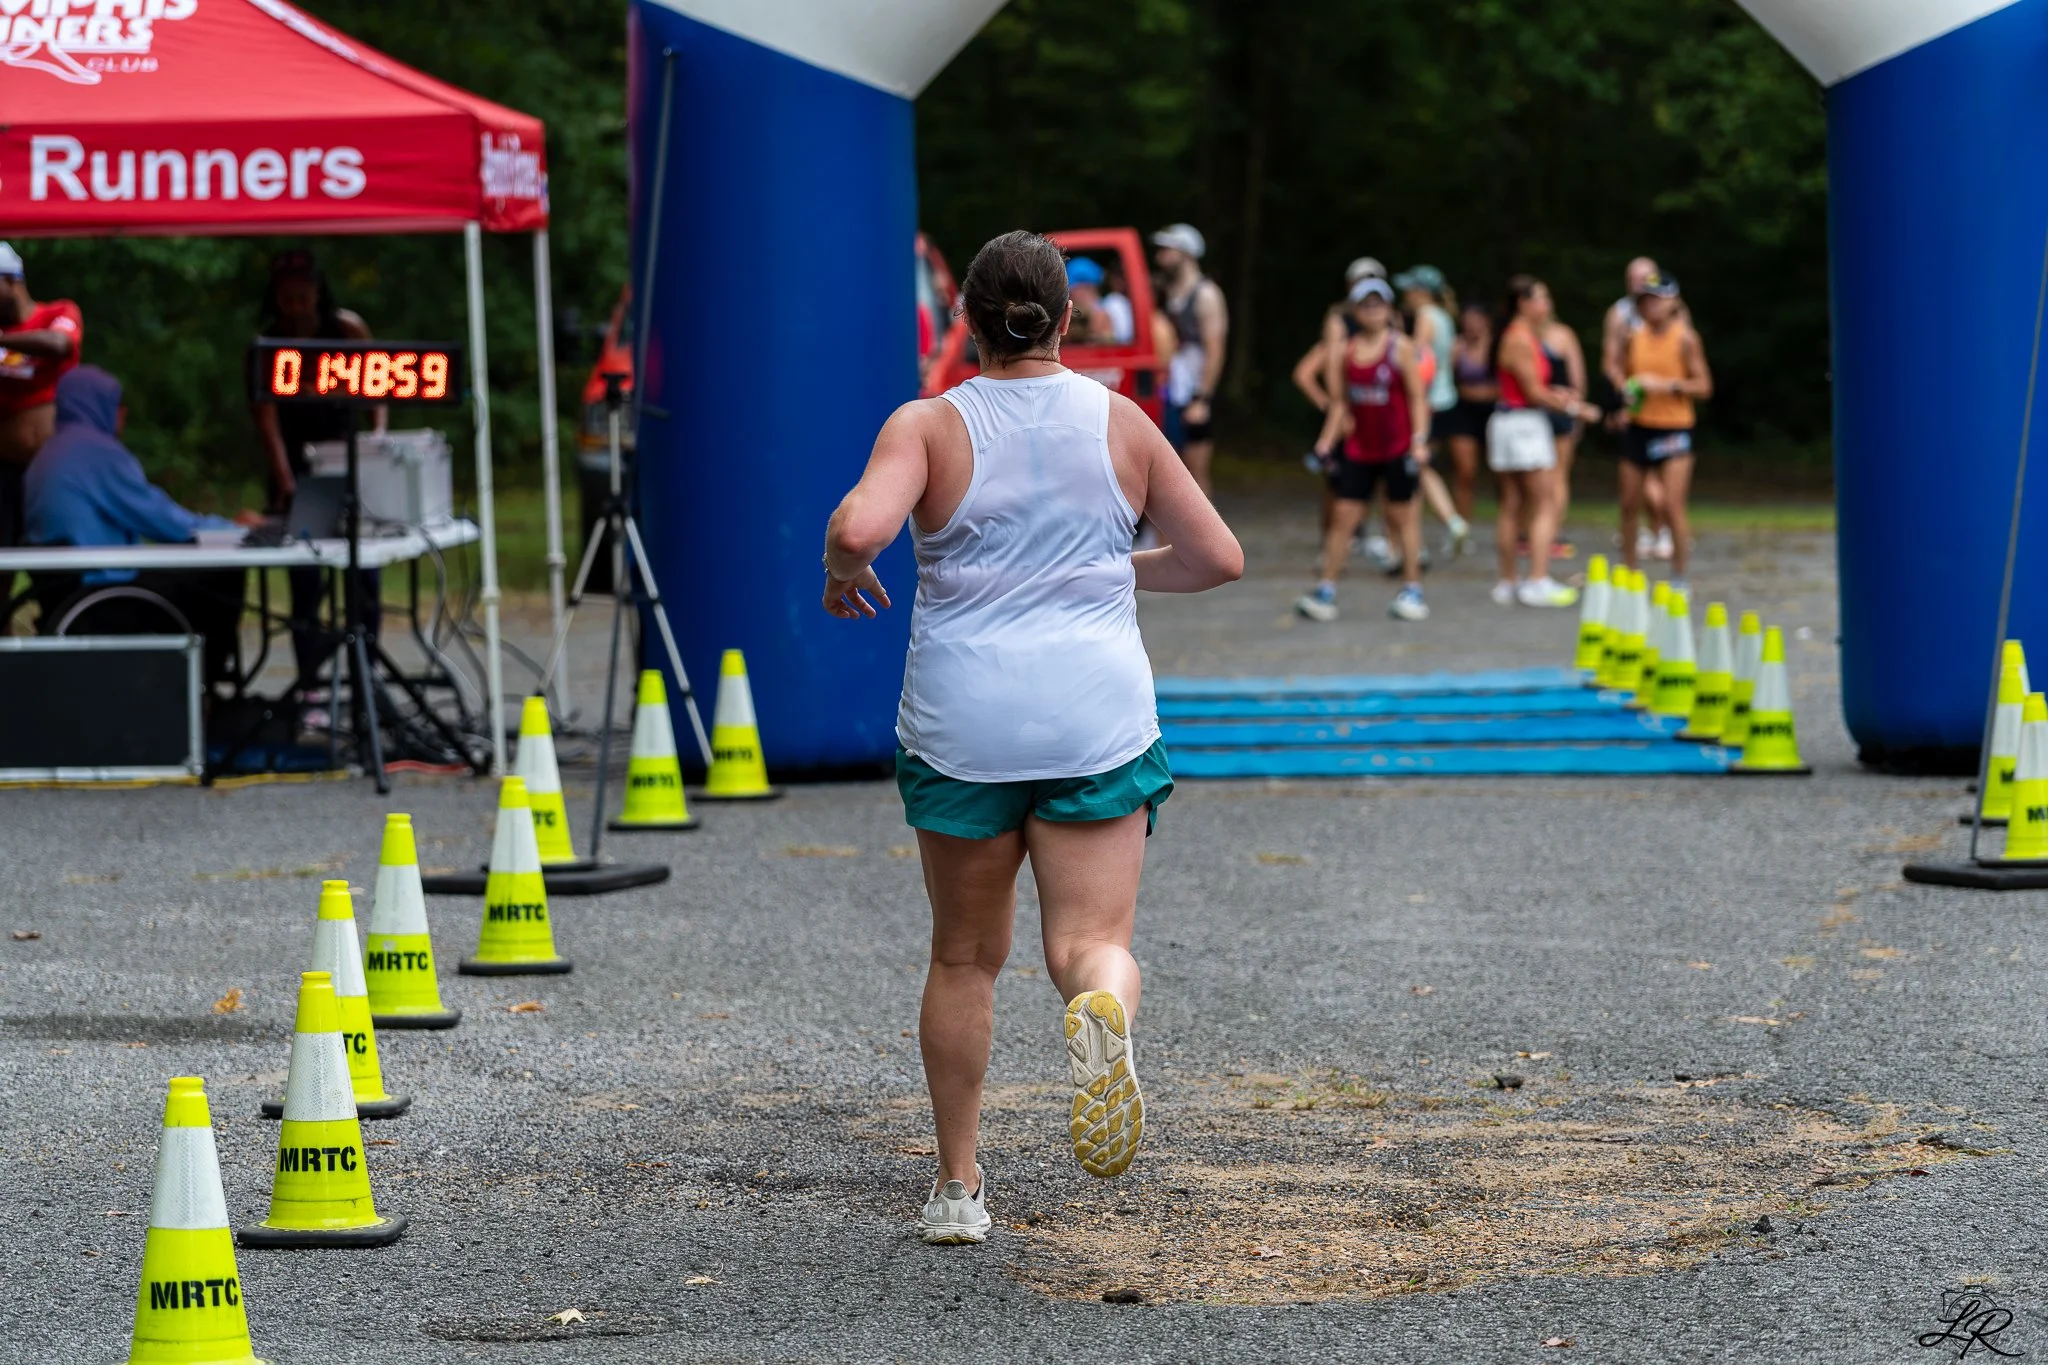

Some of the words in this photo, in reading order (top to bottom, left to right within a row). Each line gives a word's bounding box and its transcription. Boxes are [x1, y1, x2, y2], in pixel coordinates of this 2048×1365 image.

[29, 134, 367, 201] Runners
[489, 904, 545, 921] MRTC
[367, 951, 428, 970] MRTC
[280, 1145, 357, 1172] MRTC
[151, 1277, 239, 1310] MRTC
